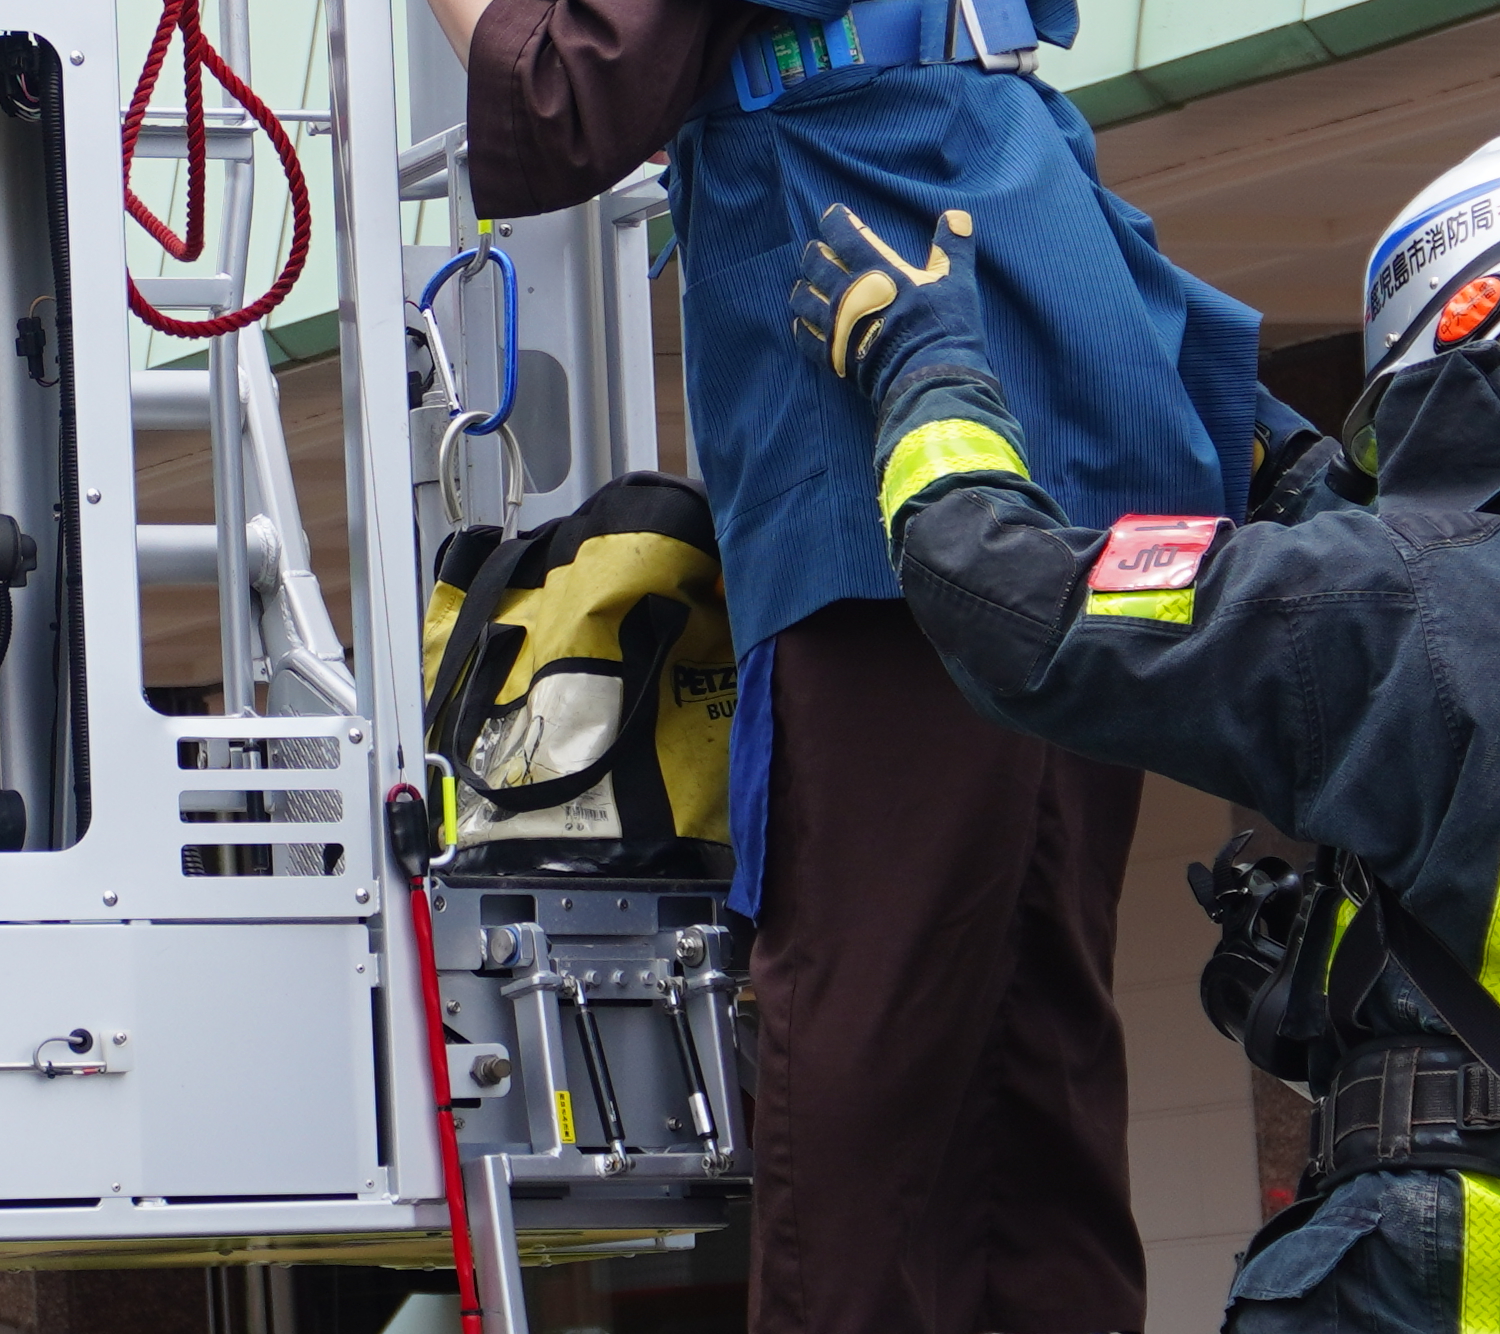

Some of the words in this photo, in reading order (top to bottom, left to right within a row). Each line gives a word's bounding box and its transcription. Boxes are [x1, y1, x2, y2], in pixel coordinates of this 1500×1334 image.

[1370, 198, 1494, 322] 鹿児島市消防局
[671, 663, 738, 708] PETZ
[706, 699, 738, 720] BU
